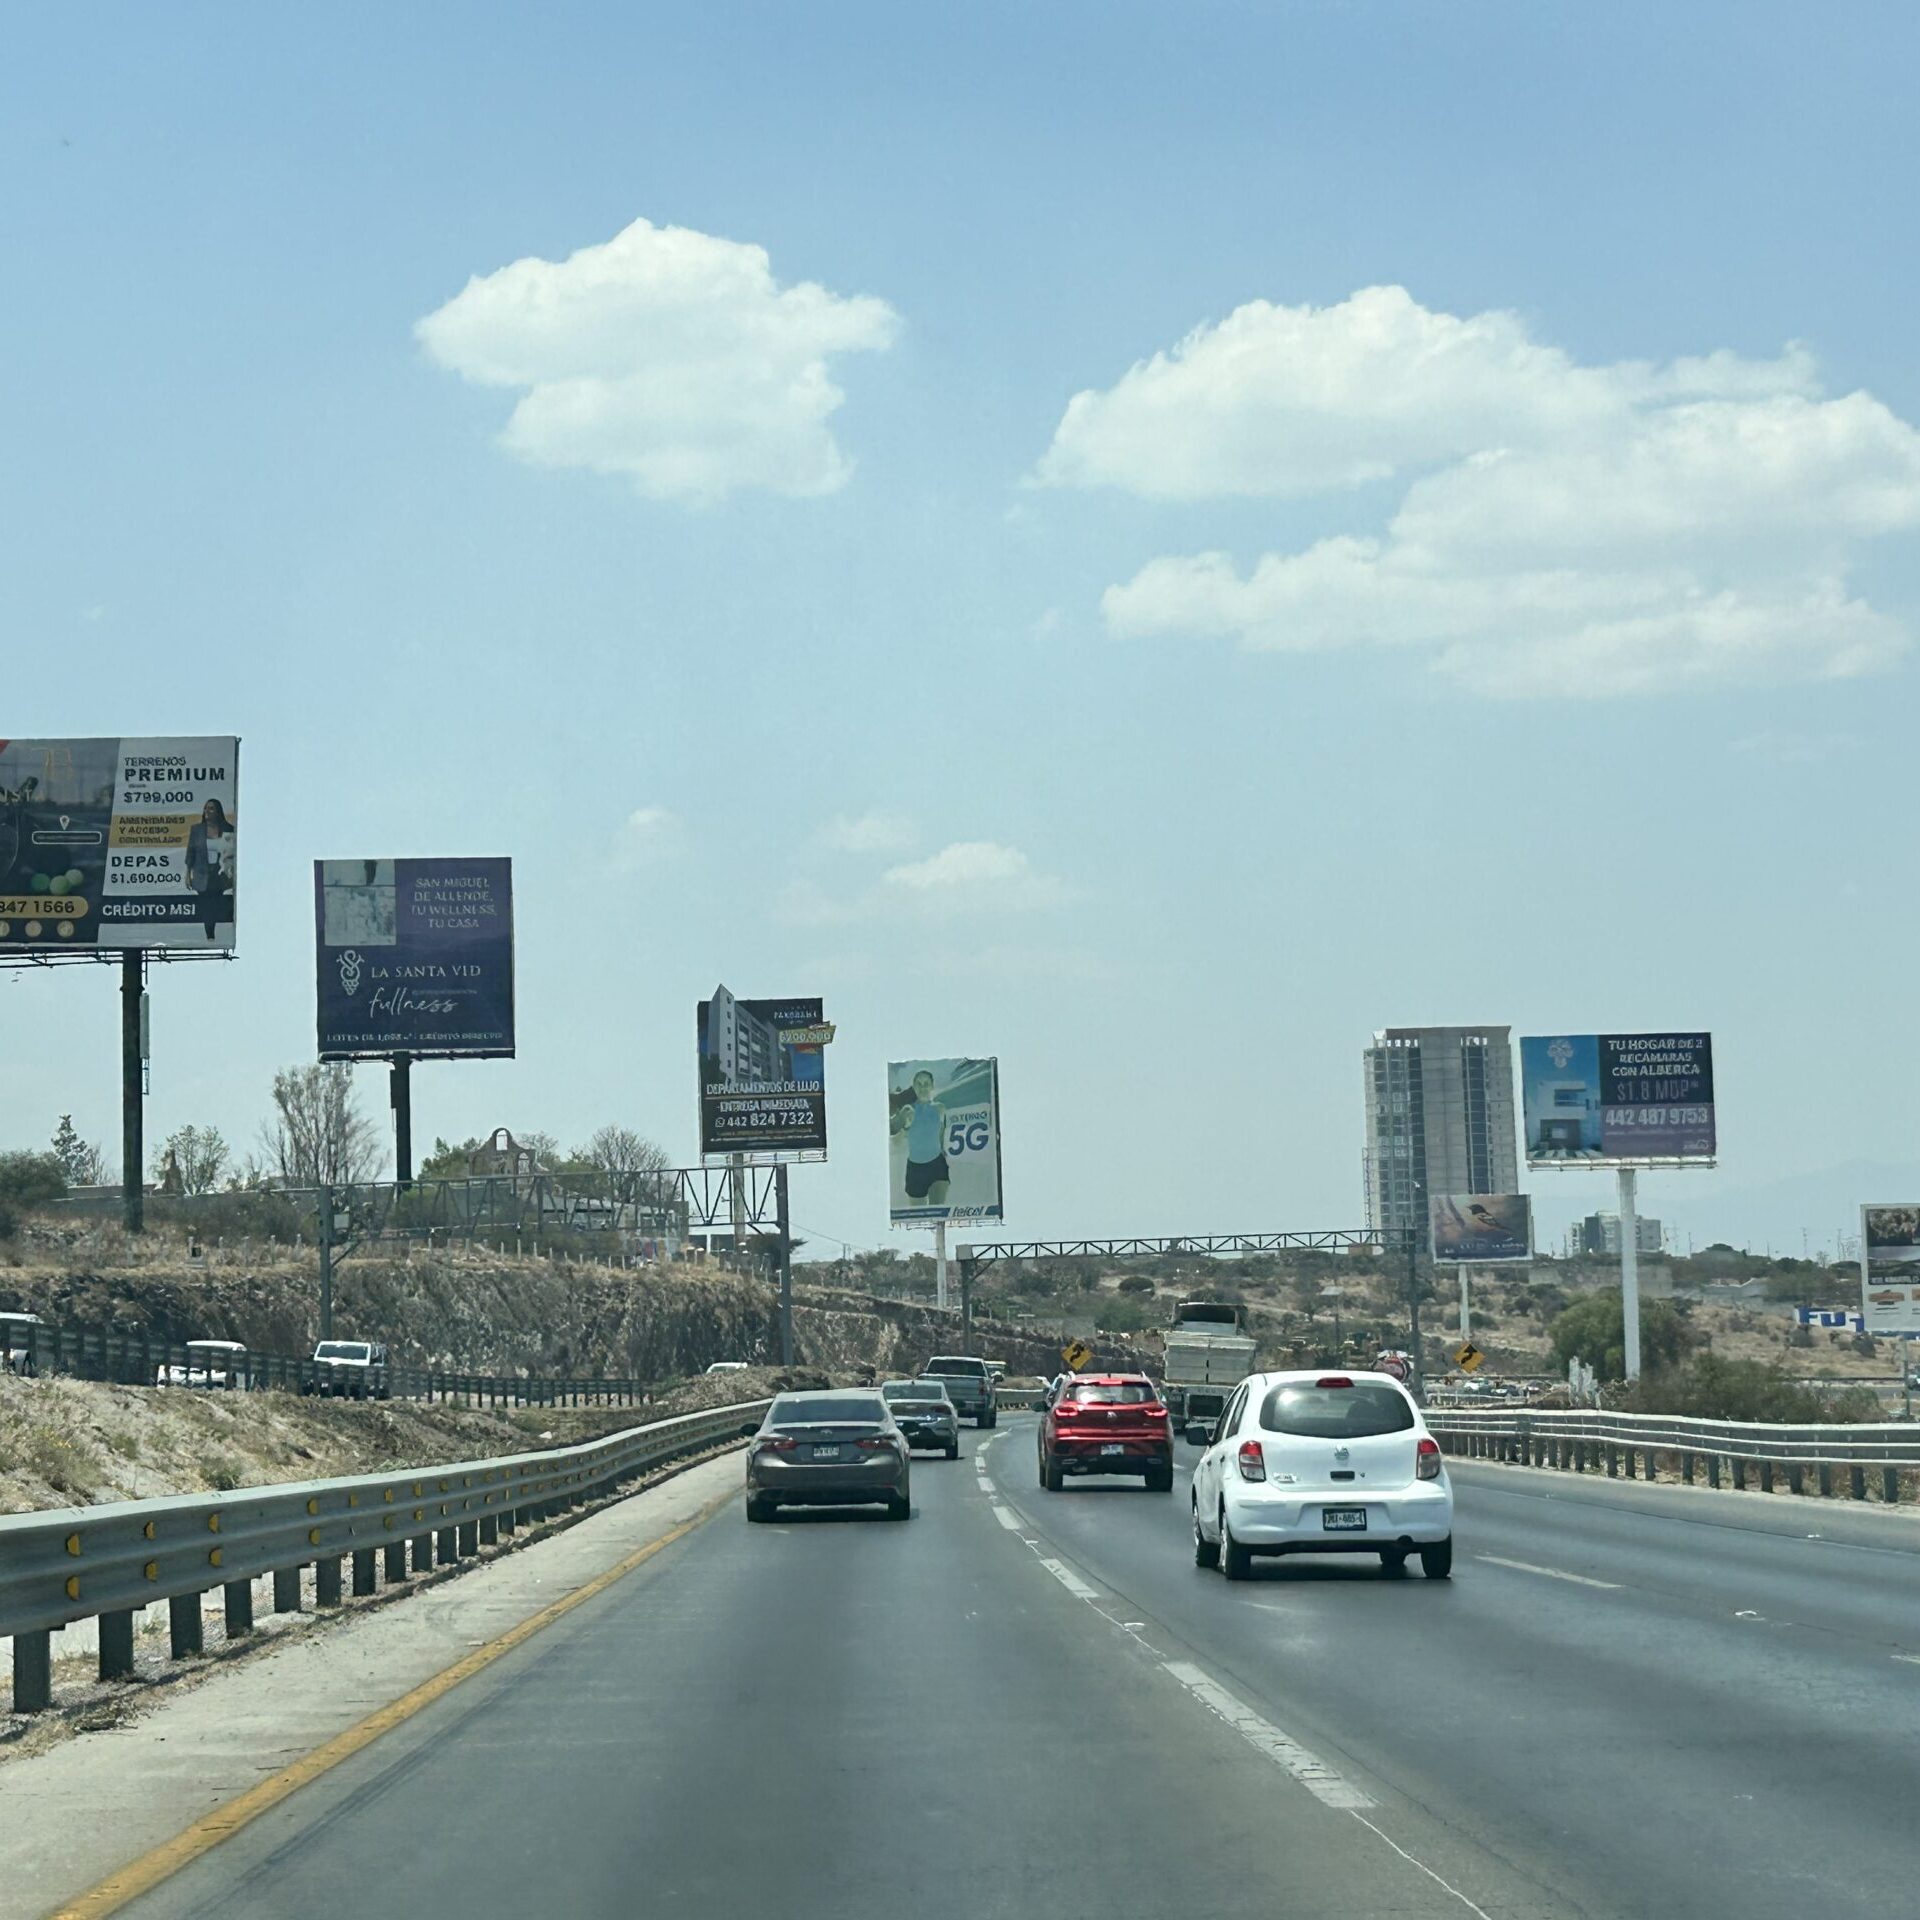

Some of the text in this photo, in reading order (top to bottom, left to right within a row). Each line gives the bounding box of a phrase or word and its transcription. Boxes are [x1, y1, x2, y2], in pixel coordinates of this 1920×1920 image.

[124, 757, 187, 767] TERRENOS
[124, 767, 225, 781] PREMIUM
[123, 791, 194, 804] $799,000
[111, 855, 170, 867] DEPAS
[415, 877, 491, 888] SAN MIGUEL
[414, 891, 431, 901] DE
[102, 902, 197, 917] CRÉDITO MSI
[428, 917, 480, 929] TU CASA
[371, 965, 481, 978] LA SANTA VID
[1608, 1040, 1626, 1051] TU
[1628, 1039, 1676, 1050] HOGAR
[1678, 1039, 1694, 1049] DE
[1612, 1064, 1700, 1076] CON ALBERCA
[706, 1081, 820, 1095] DEPARTAMENTOS DE LUJO
[727, 1111, 814, 1127] 442 824 7322
[1605, 1109, 1636, 1126] 442
[948, 1122, 989, 1156] 5G
